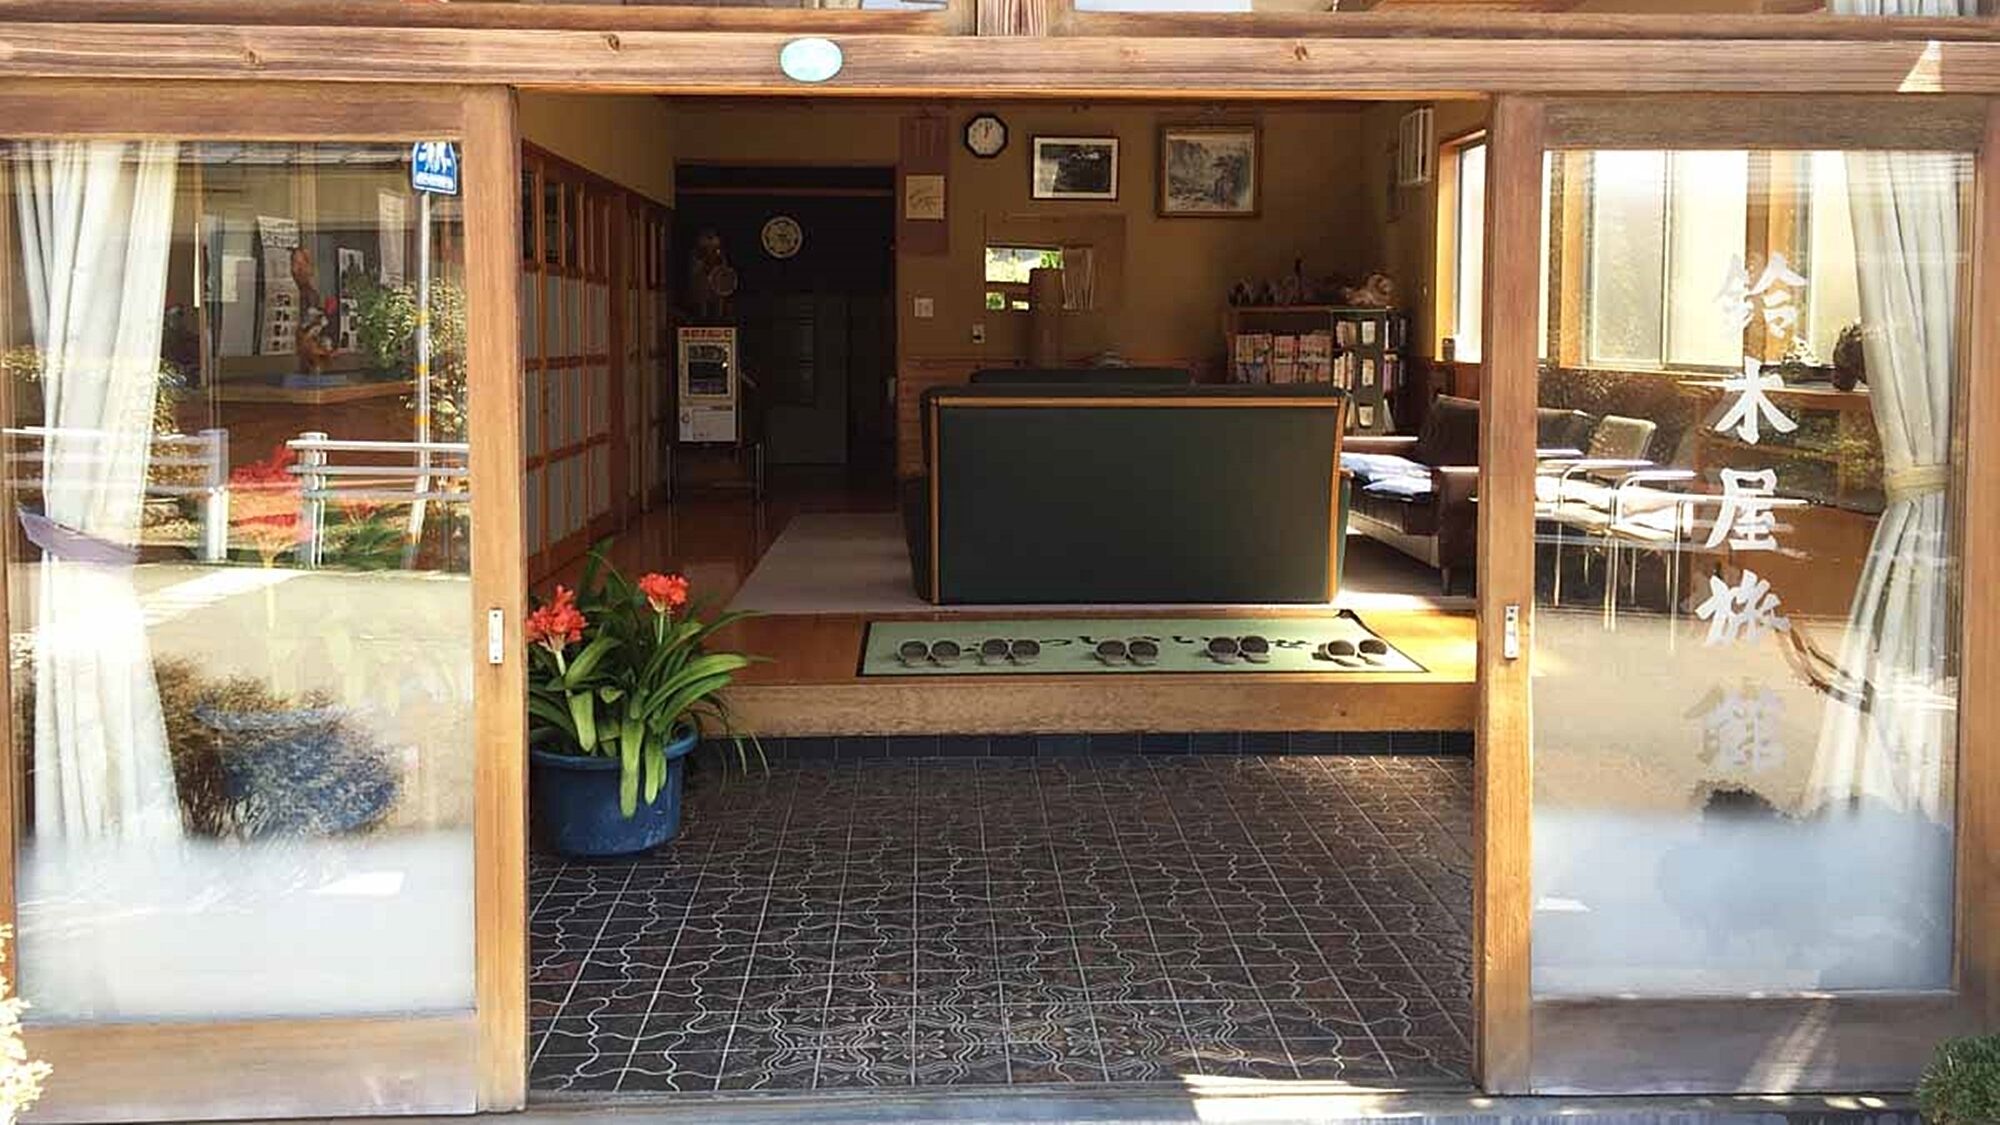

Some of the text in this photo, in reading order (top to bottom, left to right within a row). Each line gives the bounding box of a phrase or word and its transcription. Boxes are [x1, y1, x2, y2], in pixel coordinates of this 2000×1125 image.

[1684, 252, 1808, 773] 鈴木屋旅館
